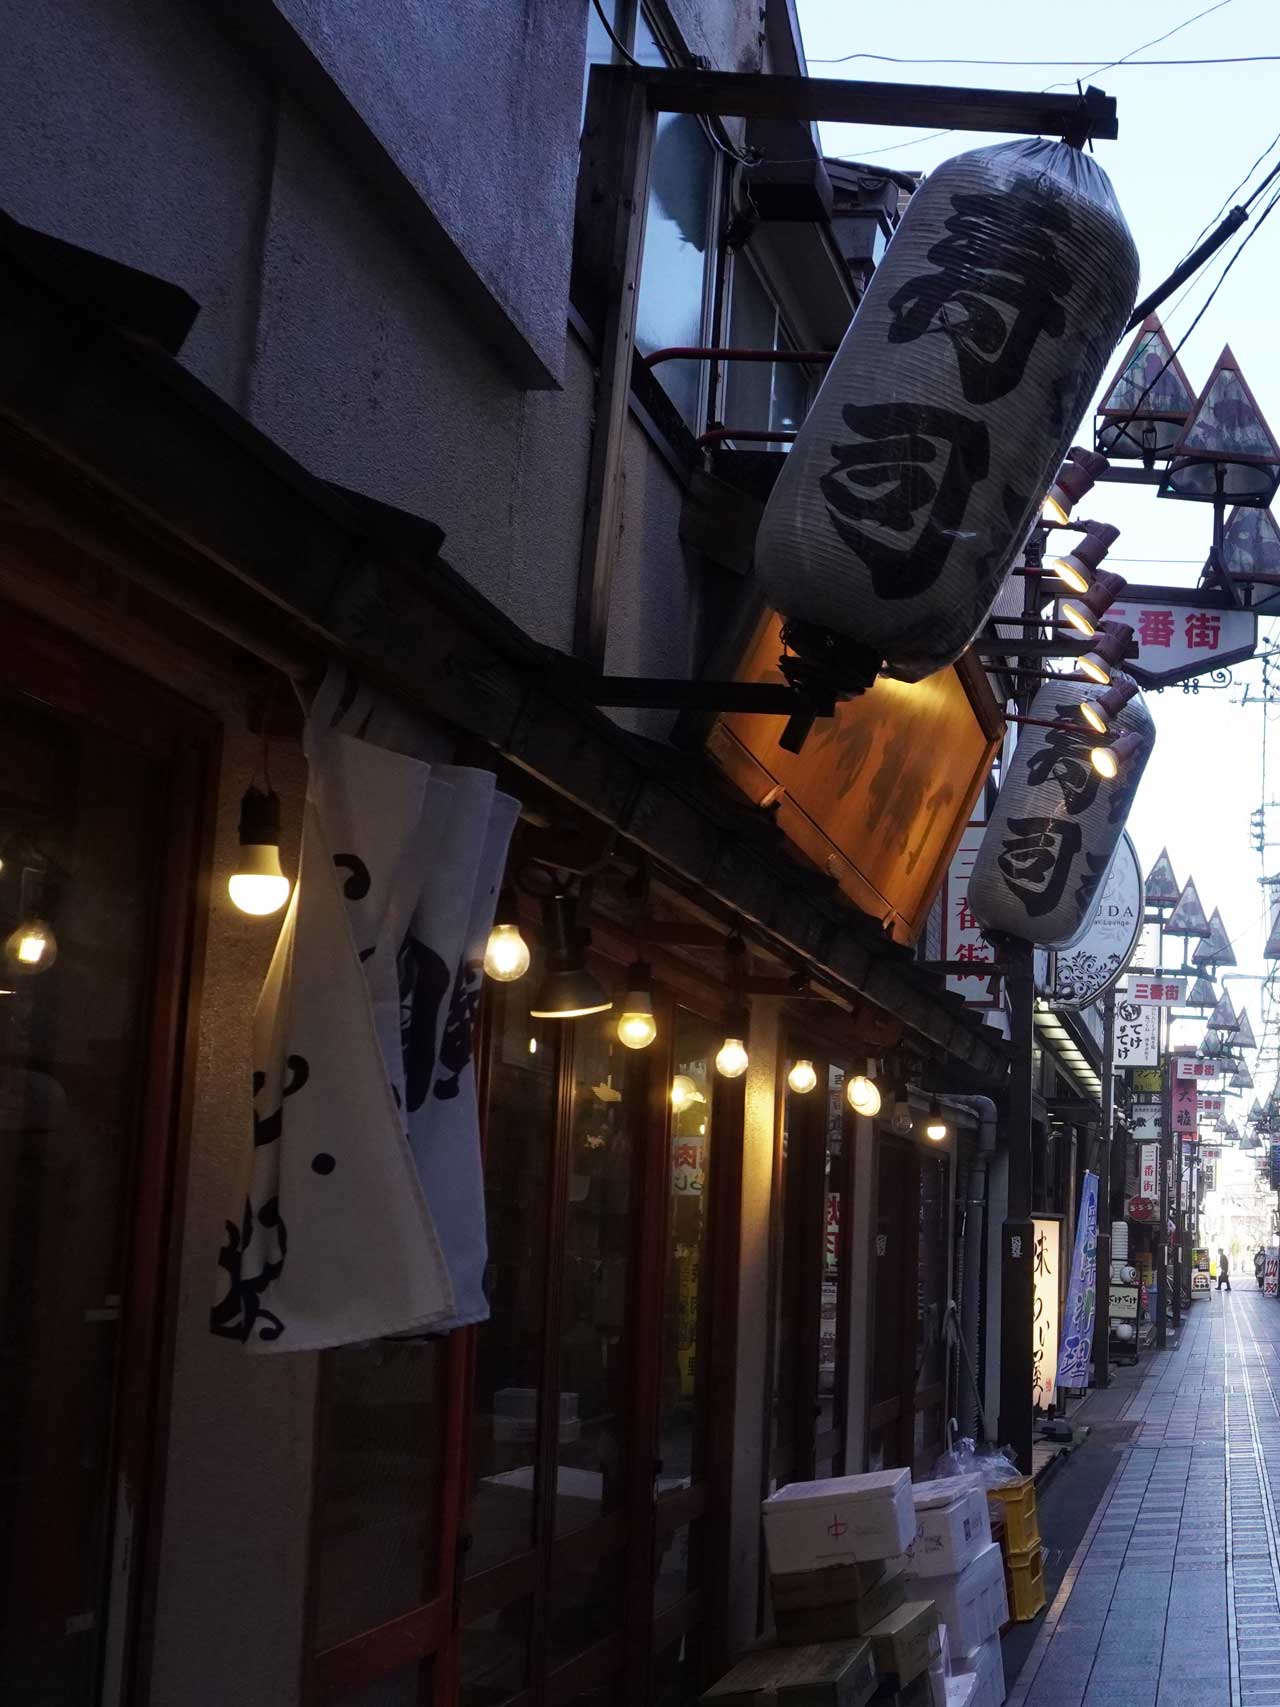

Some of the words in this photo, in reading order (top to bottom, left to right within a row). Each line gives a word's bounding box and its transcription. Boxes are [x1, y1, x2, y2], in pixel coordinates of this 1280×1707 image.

[818, 193, 1074, 600] 寿司
[998, 701, 1102, 918] 寿司
[1135, 984, 1179, 1000] 三番街
[1183, 1064, 1215, 1076] 三番街
[1143, 1150, 1154, 1192] 三番街
